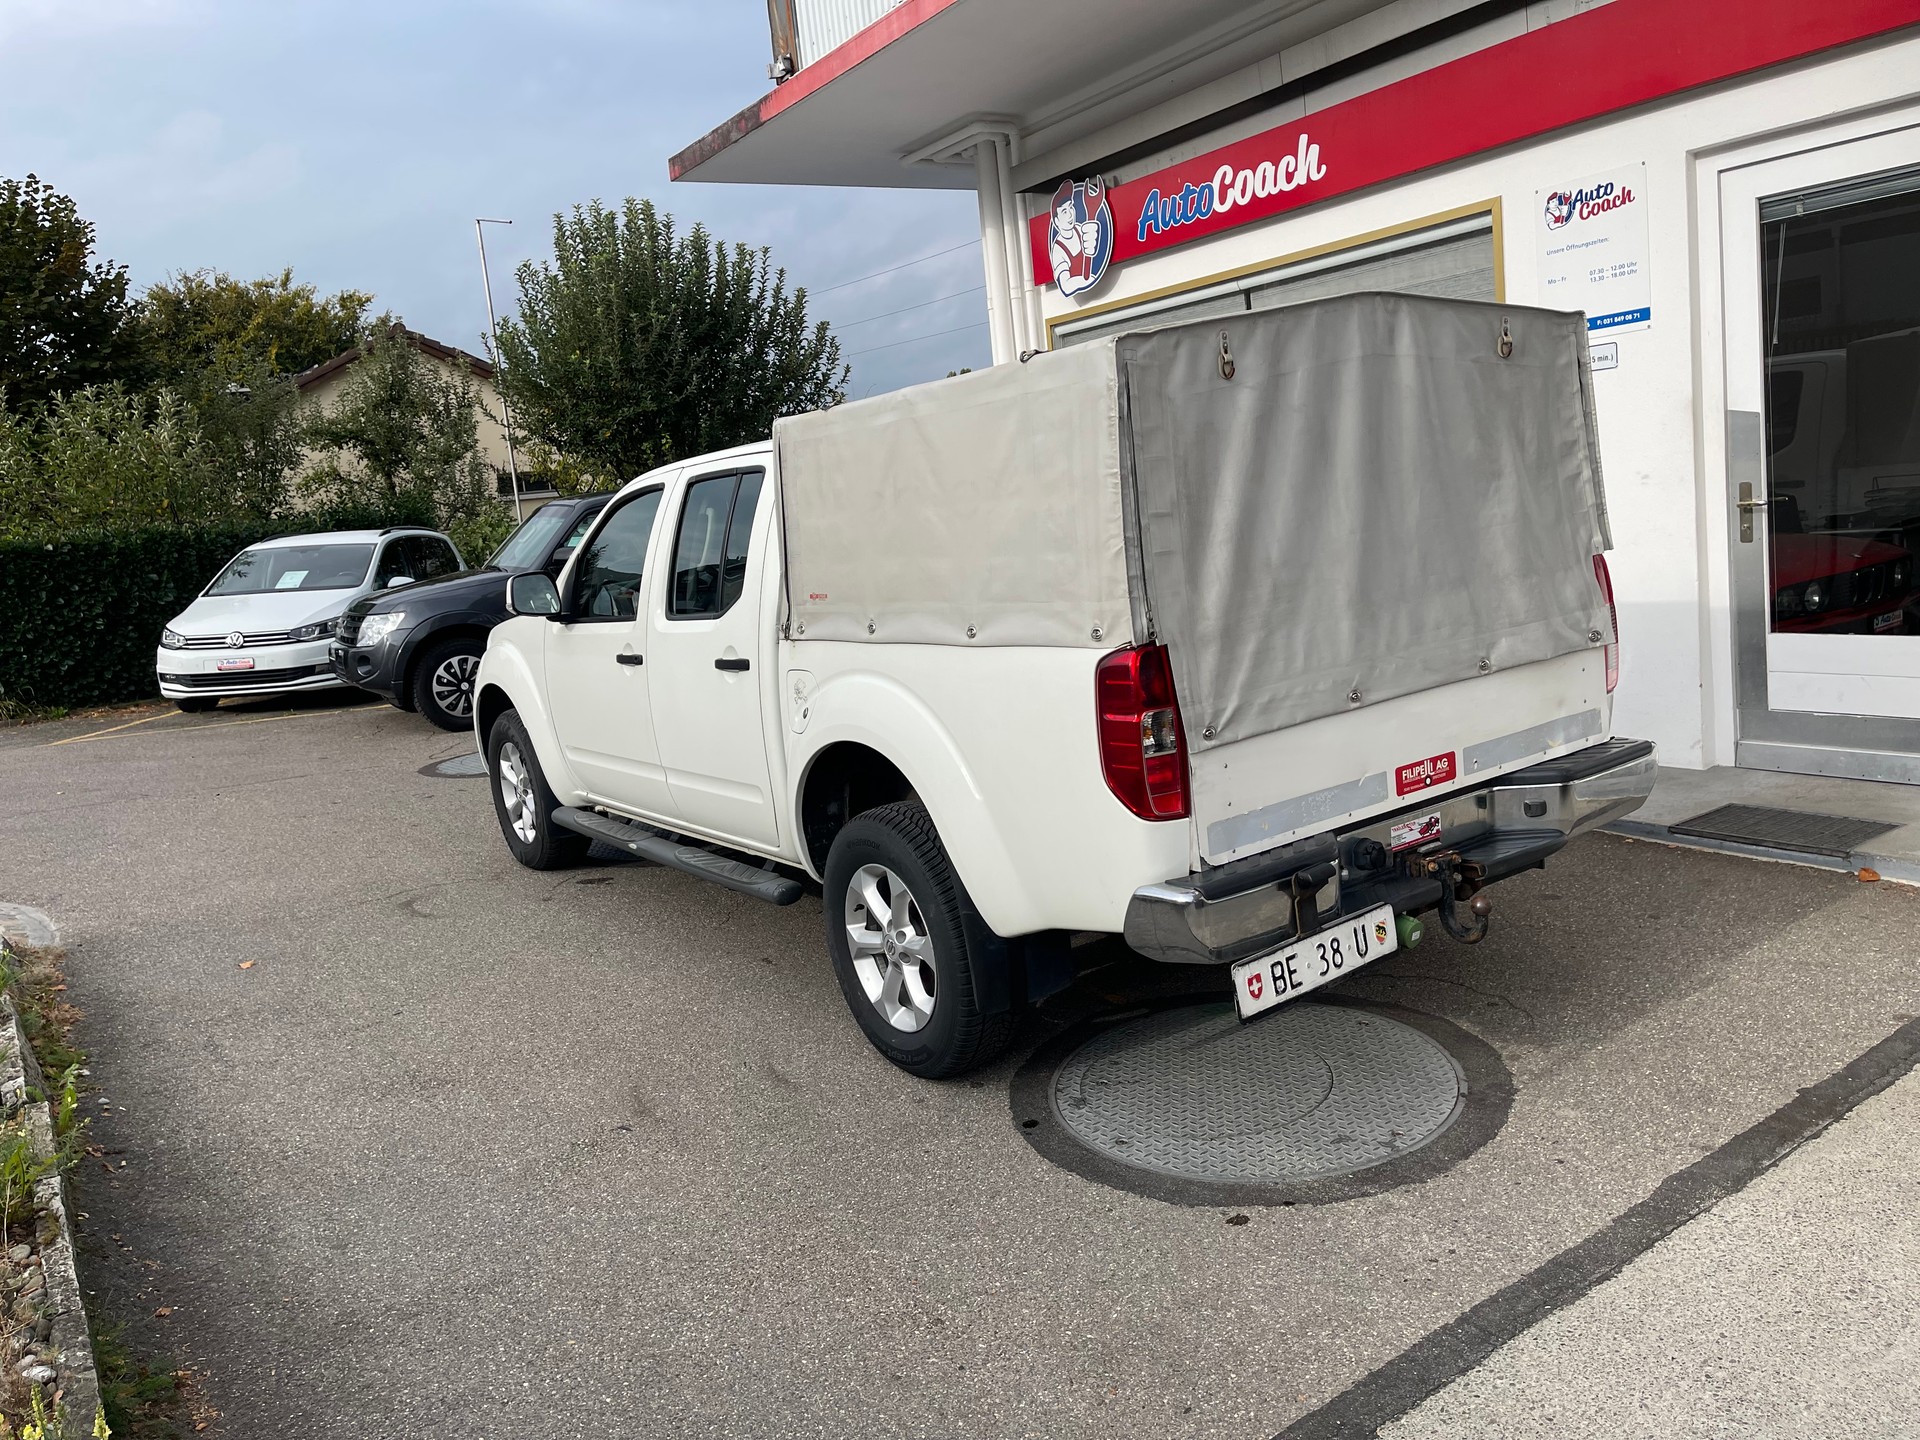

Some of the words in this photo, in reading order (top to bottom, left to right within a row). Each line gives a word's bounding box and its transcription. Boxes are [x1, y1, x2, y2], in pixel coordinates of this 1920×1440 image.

[1572, 182, 1614, 210] Auto
[1579, 186, 1635, 220] Coach
[1546, 247, 1565, 256] Unsere
[1565, 236, 1610, 252] Öffnungszeiten:
[1589, 267, 1605, 276] 07.30
[1610, 263, 1625, 272] 12.00
[1626, 261, 1637, 269] Uhr
[1590, 275, 1605, 283] 13.30
[1611, 270, 1626, 279] 18.00
[1627, 268, 1638, 276] Uhr
[1603, 317, 1613, 325] 031
[1402, 759, 1435, 781] FILIPELLI
[1436, 757, 1449, 770] AG
[1269, 952, 1304, 997] BE
[1315, 937, 1344, 976] 38
[1353, 923, 1369, 959] U
